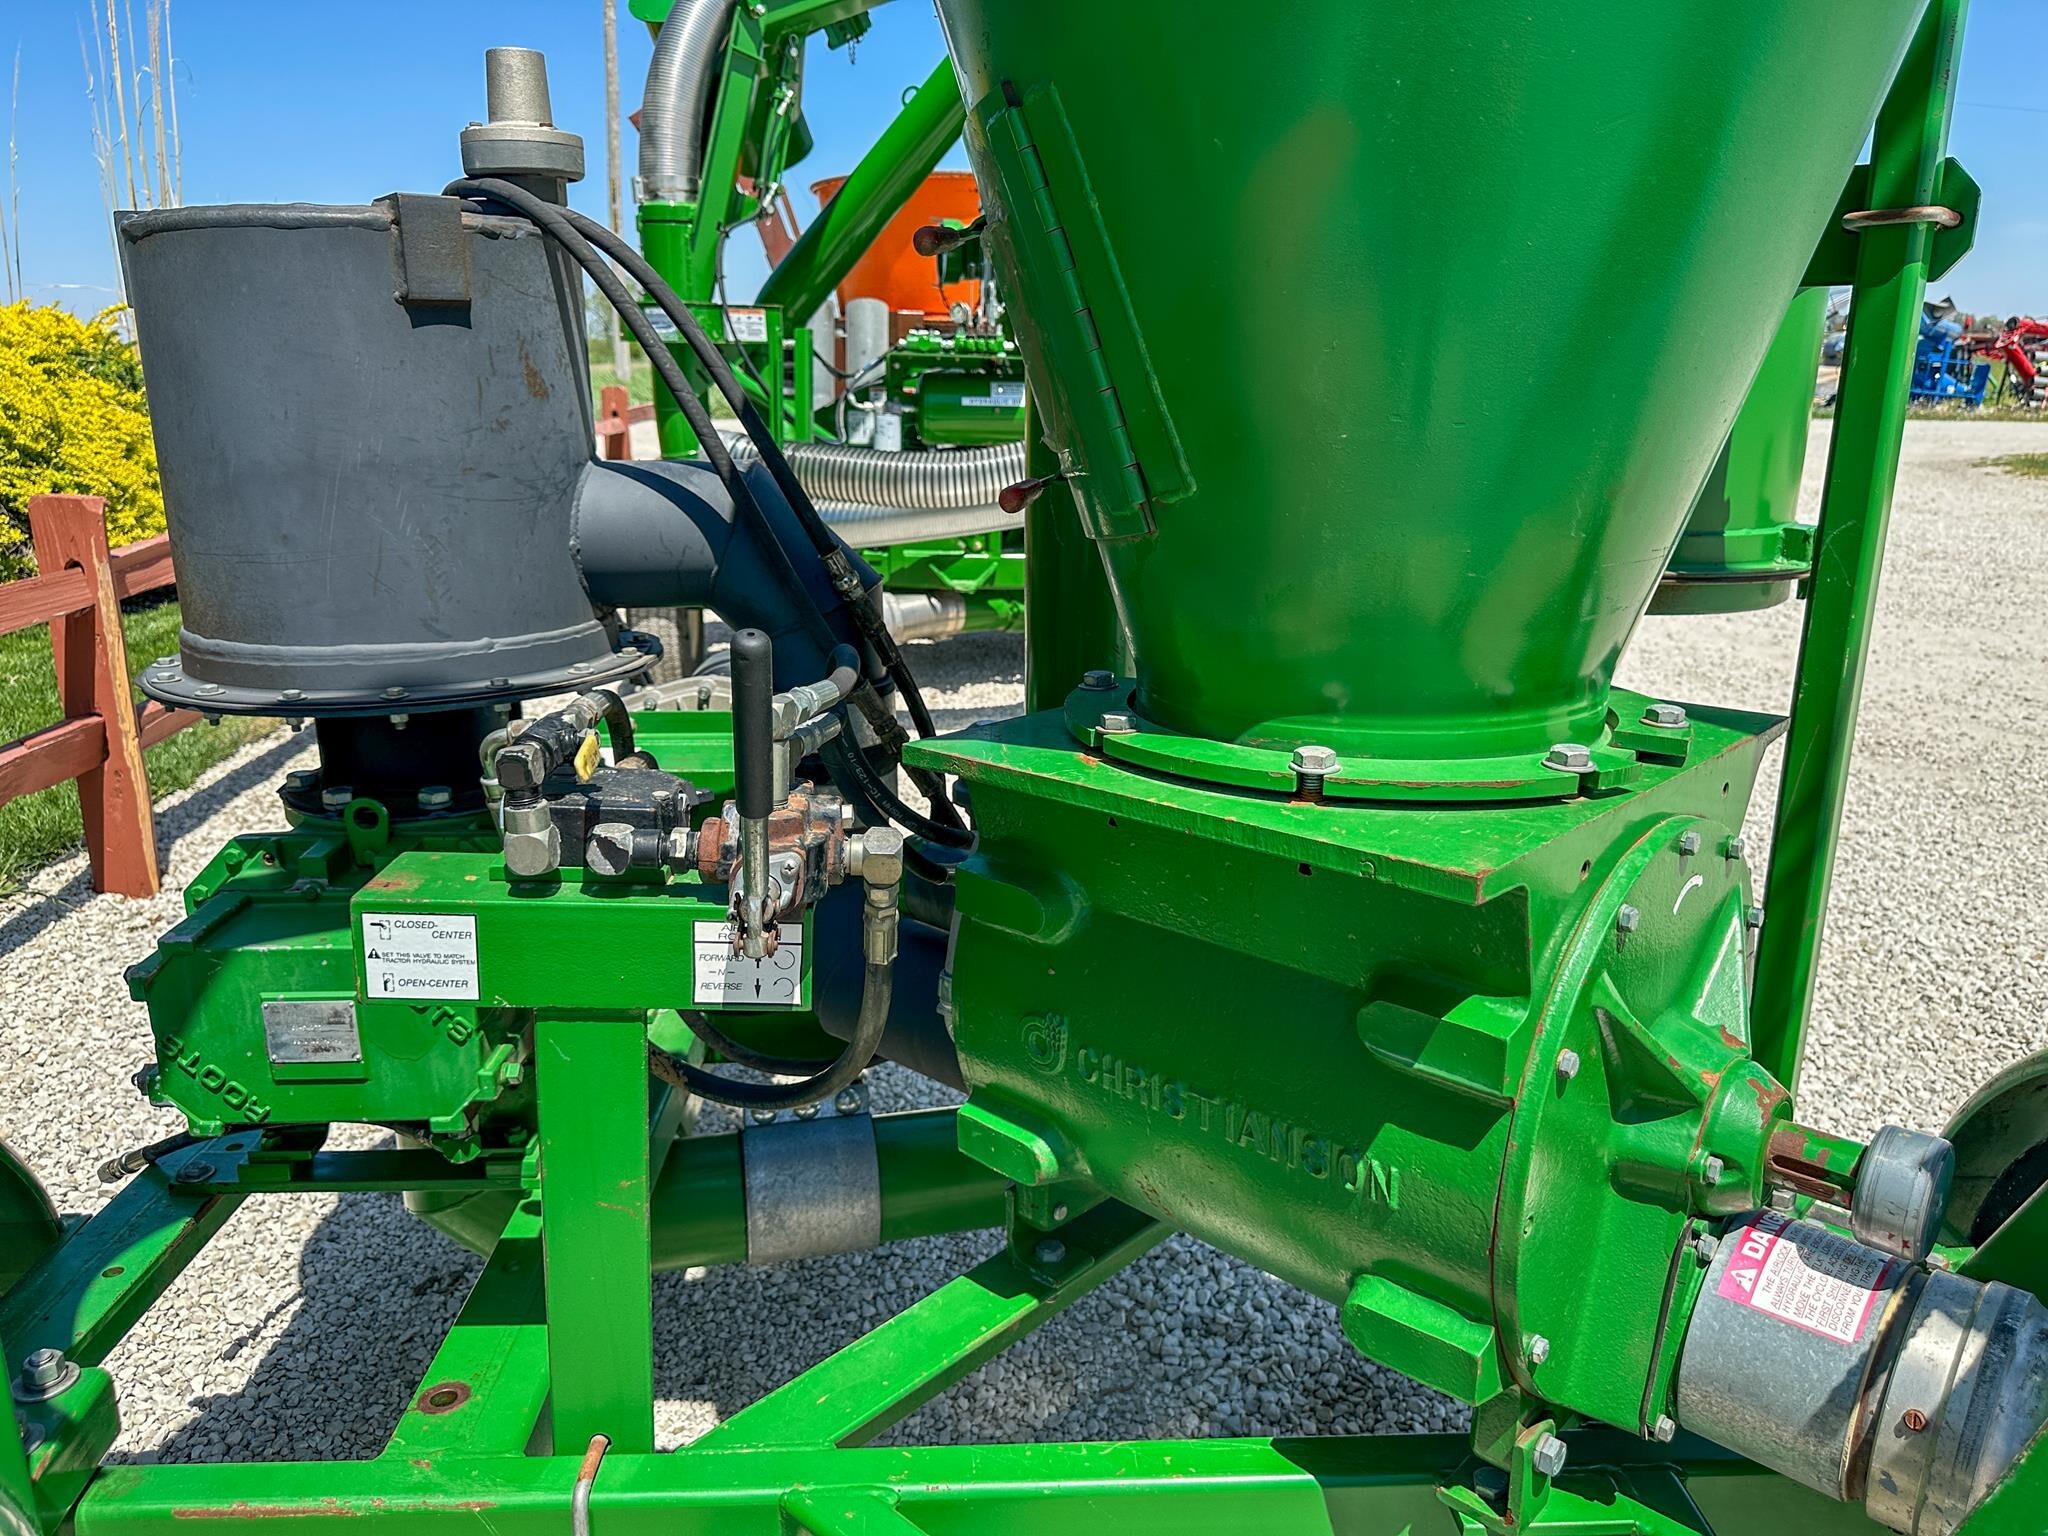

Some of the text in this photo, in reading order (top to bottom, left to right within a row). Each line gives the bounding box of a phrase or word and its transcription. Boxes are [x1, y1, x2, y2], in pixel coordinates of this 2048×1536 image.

[394, 920, 438, 929] CLOSED-
[431, 930, 472, 940] CENTER
[398, 978, 469, 988] OPEN-CENTER
[700, 982, 743, 991] REVERSE
[161, 1034, 271, 1122] ROOTS
[1077, 1047, 1400, 1211] CHRISTIANSON
[1762, 1275, 1775, 1293] THE
[1769, 1244, 1791, 1275] AIRLOCK
[1769, 1275, 1789, 1308] ALWAYS
[1793, 1291, 1809, 1316] MOVE
[1803, 1273, 1816, 1289] THE
[1805, 1302, 1818, 1320] THE
[1815, 1300, 1832, 1325] FIRST
[1839, 1307, 1856, 1335] FROM
